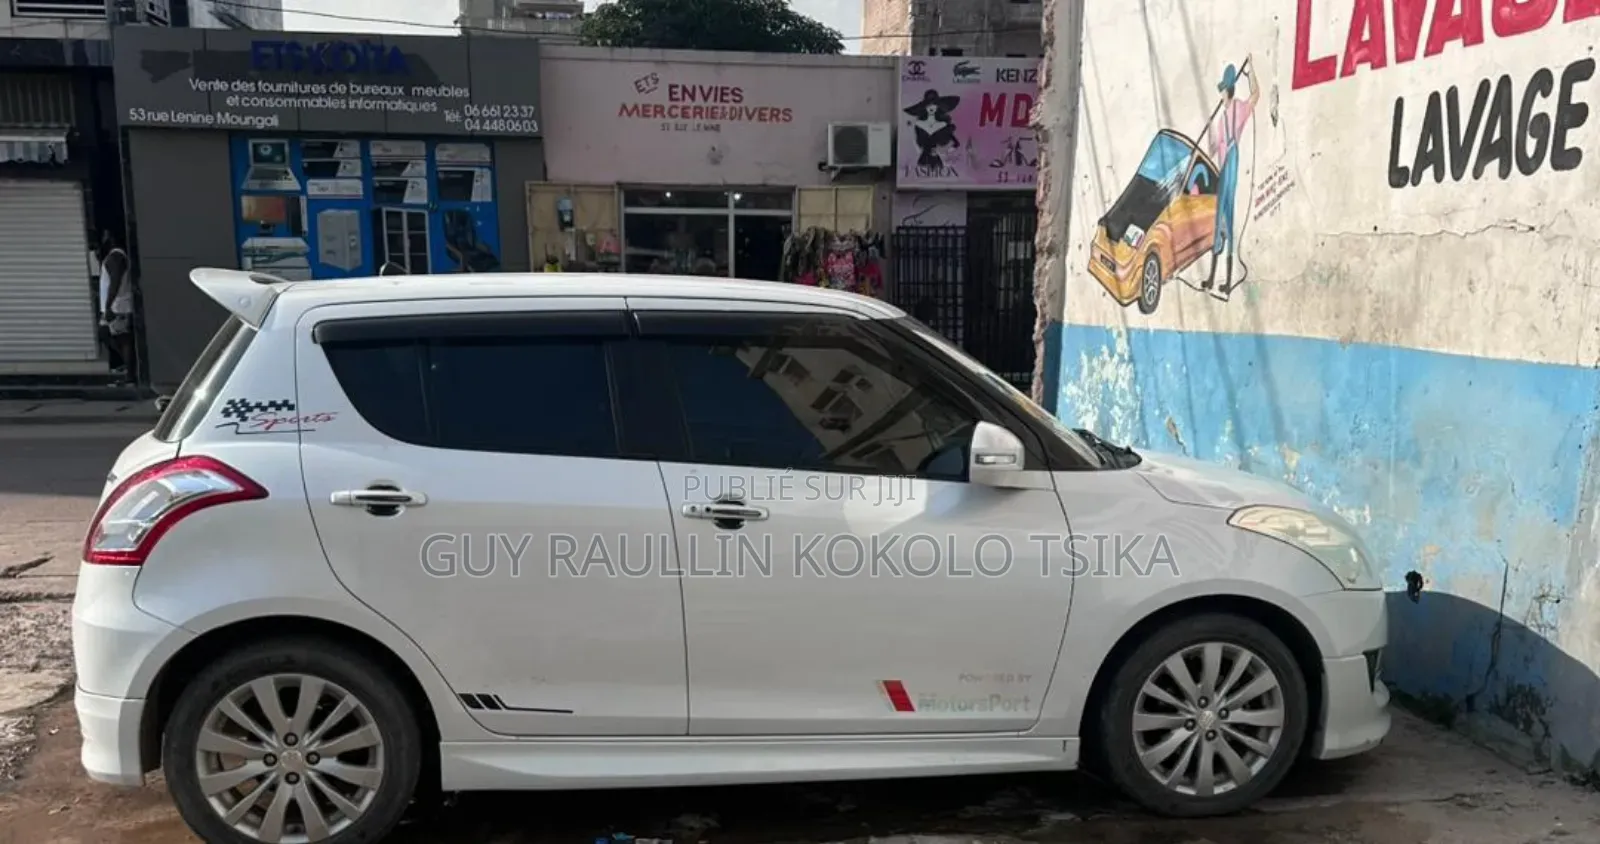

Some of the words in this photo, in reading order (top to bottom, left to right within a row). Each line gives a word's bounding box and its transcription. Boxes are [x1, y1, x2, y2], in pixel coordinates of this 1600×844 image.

[1292, 0, 1600, 91] LAVA
[189, 78, 229, 92] Vente
[231, 80, 256, 93] des
[257, 80, 327, 95] fournitures
[328, 82, 347, 95] de
[349, 83, 405, 97] bureaux
[411, 85, 470, 98] meubles
[633, 72, 659, 94] ETS
[667, 84, 744, 103] ENVIES
[226, 95, 240, 107] et
[241, 97, 346, 110] consommables
[348, 97, 438, 114] informatiques
[464, 104, 480, 117] 06
[503, 105, 519, 118] 23
[520, 105, 535, 119] 37
[129, 108, 146, 121] 53
[147, 110, 169, 122] rue
[171, 110, 215, 125] Lenine
[216, 112, 279, 129] Moungali
[464, 118, 481, 131] 04
[1388, 58, 1596, 188] LAVAGE
[249, 411, 339, 430] Sports
